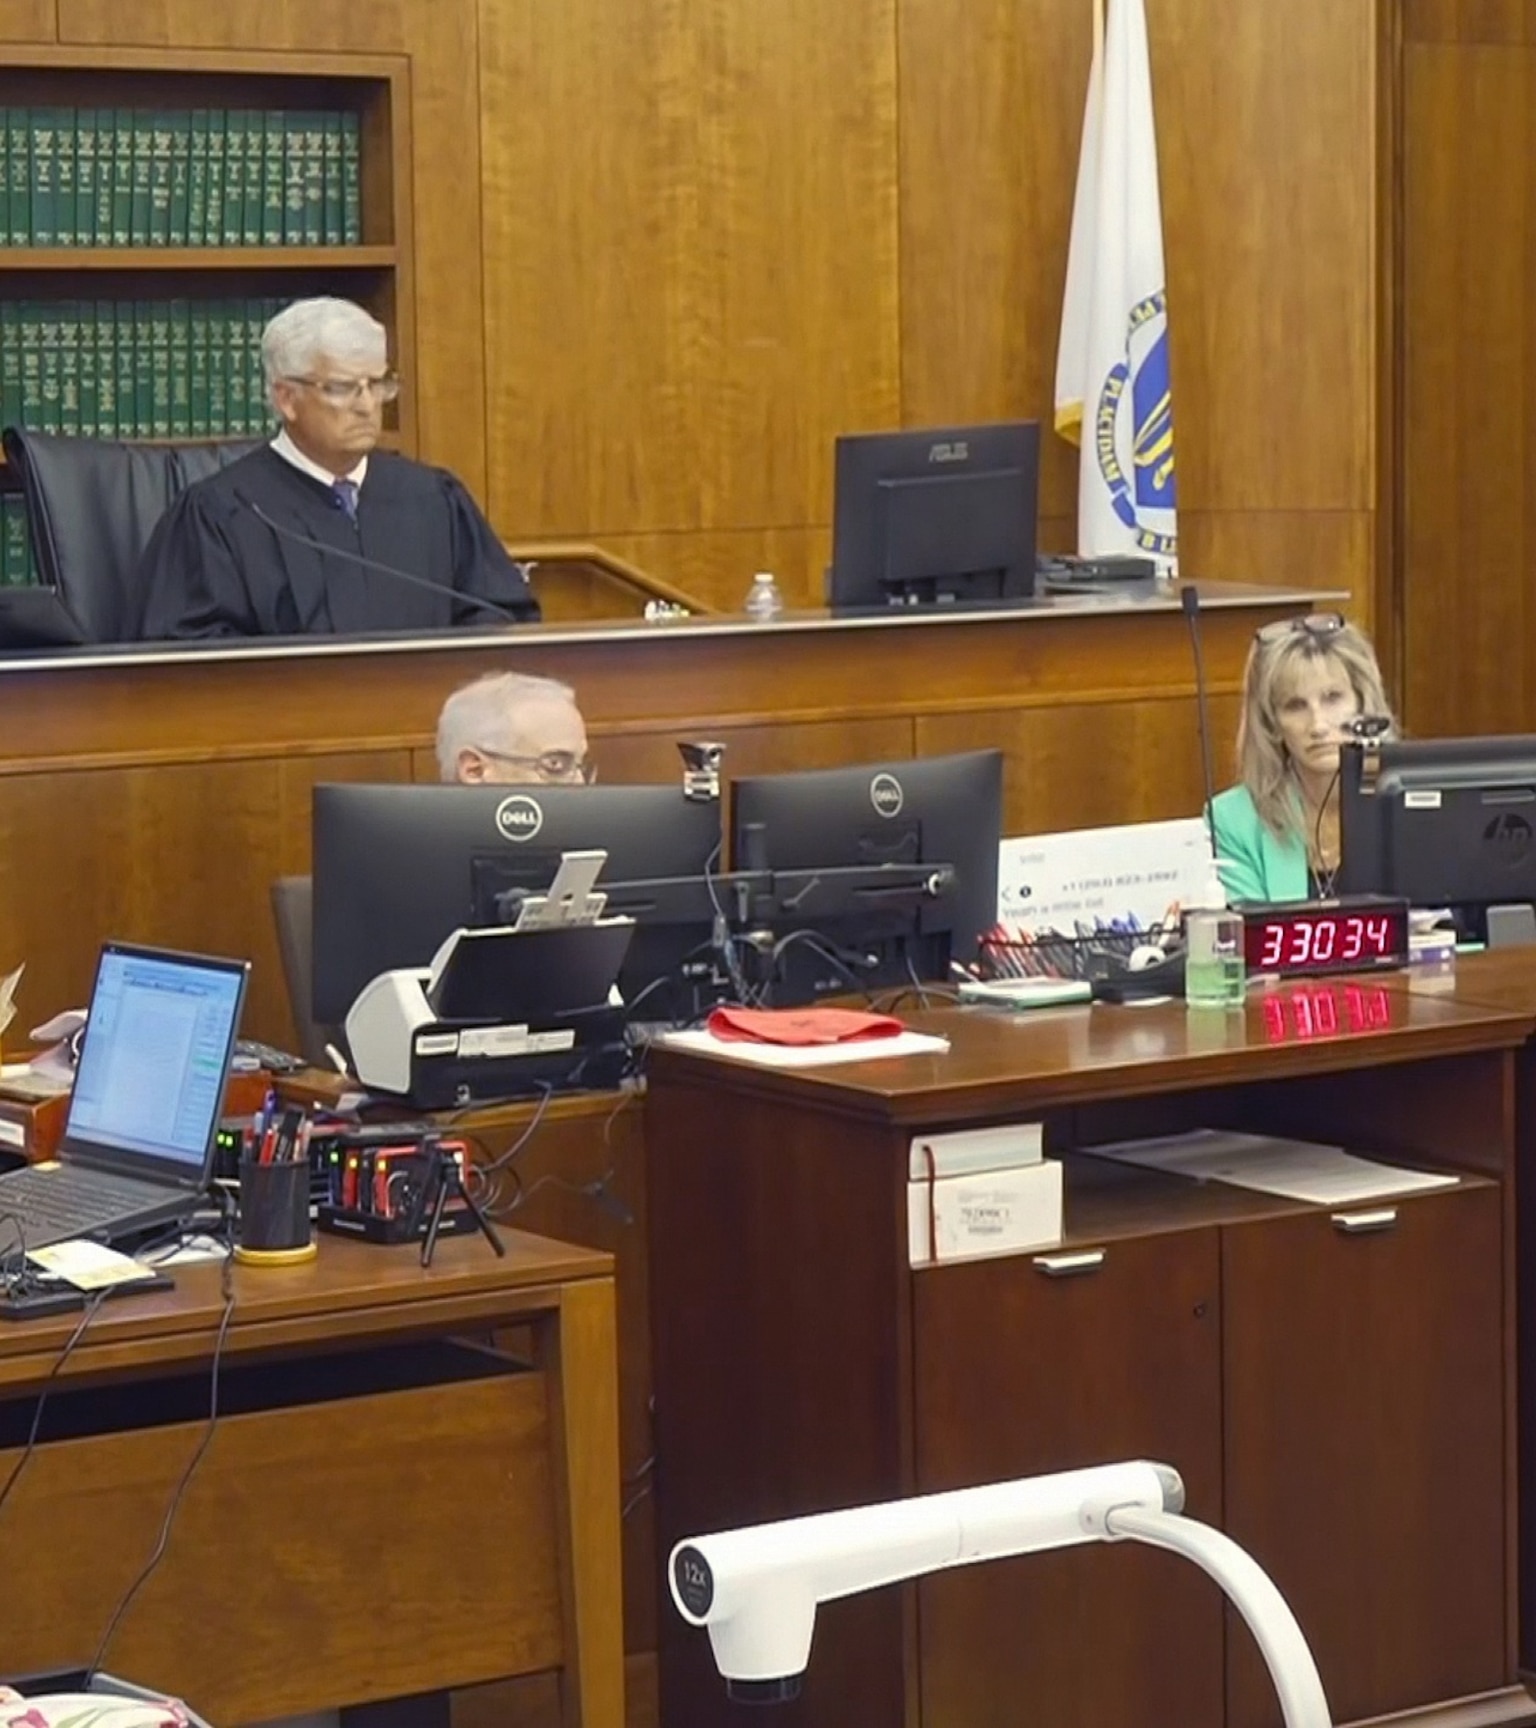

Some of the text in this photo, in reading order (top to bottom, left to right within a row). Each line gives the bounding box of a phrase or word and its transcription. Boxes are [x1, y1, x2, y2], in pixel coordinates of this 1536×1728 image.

[929, 442, 968, 461] ASUS
[875, 789, 899, 802] DELL
[502, 811, 536, 826] DELL
